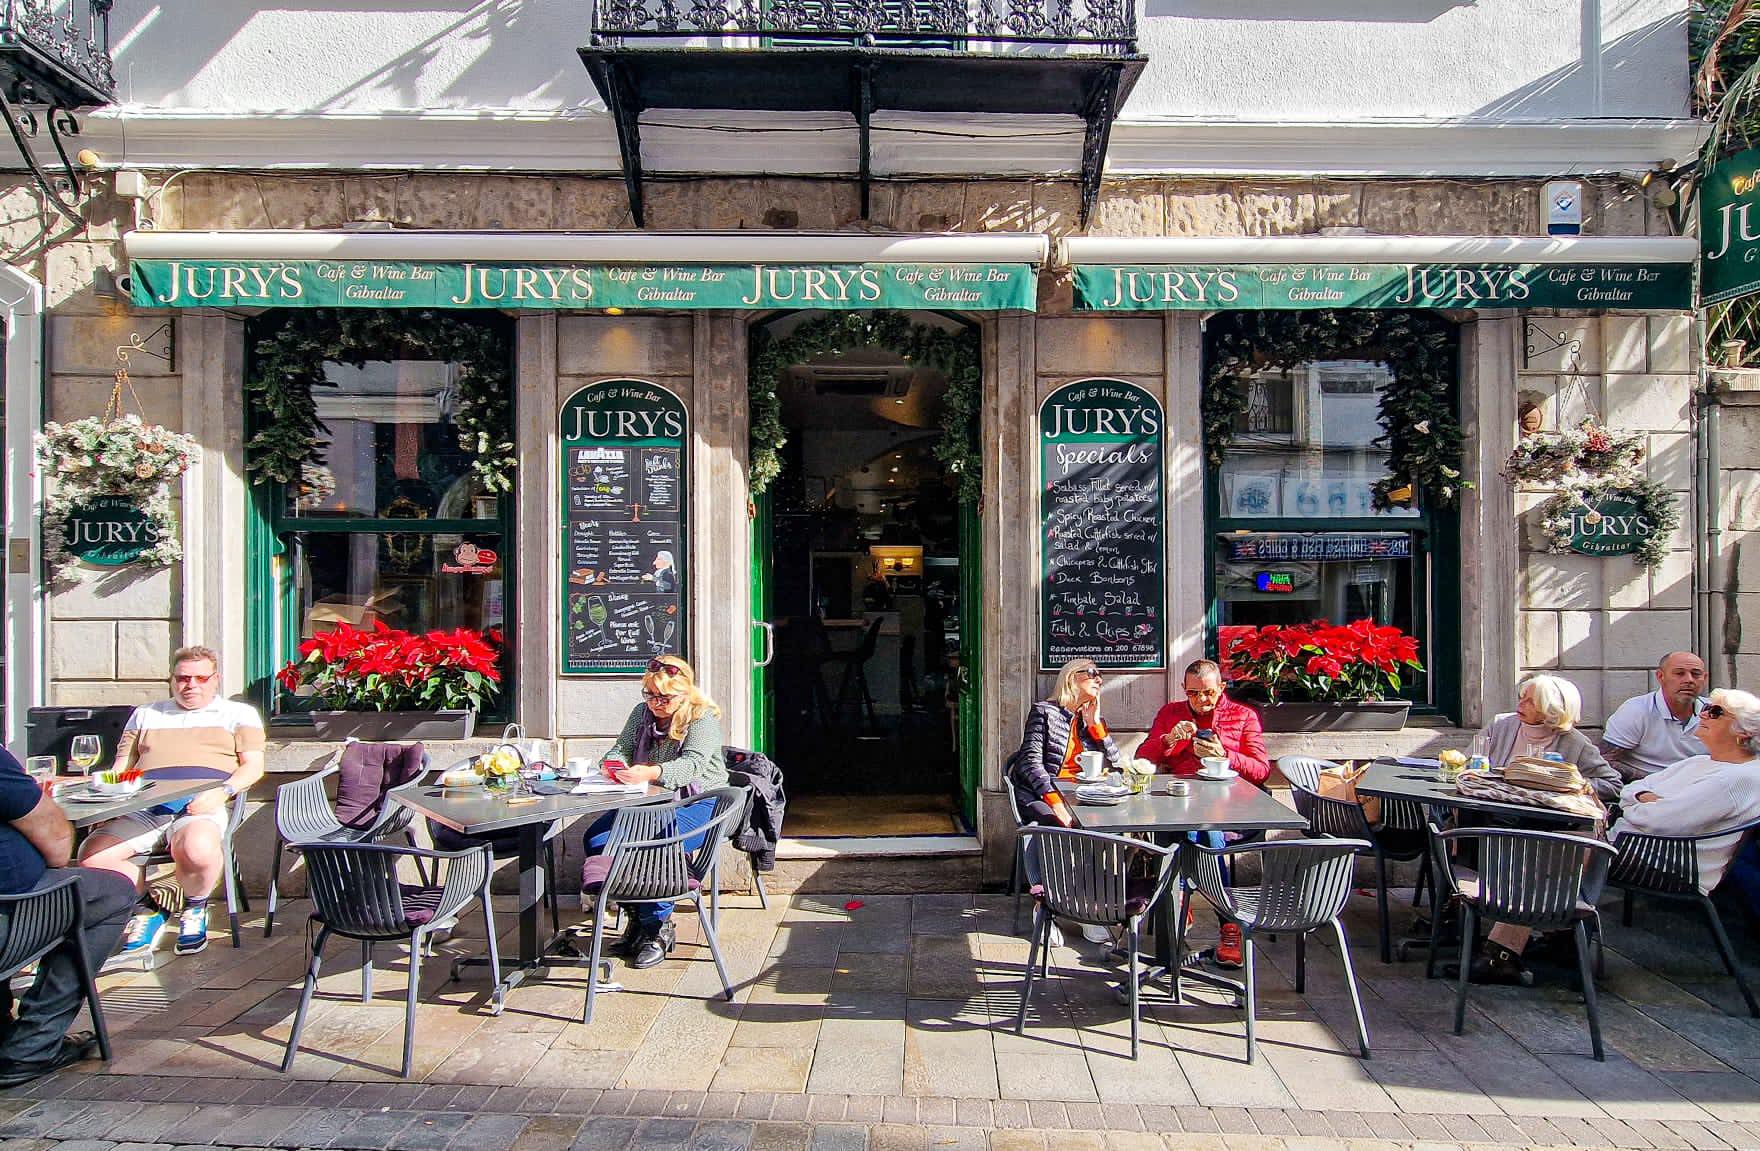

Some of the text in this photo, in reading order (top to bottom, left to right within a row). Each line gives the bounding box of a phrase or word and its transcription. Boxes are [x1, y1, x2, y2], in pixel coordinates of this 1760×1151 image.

[351, 264, 368, 279] &
[372, 265, 406, 280] Wine
[410, 266, 436, 280] Bar
[641, 267, 657, 281] &
[663, 267, 697, 281] Wine
[700, 267, 726, 281] Bar
[928, 268, 944, 281] &
[949, 268, 982, 281] Wine
[985, 268, 1010, 282] Bar
[1291, 268, 1307, 281] &
[1312, 268, 1345, 281] Wine
[1348, 268, 1373, 281] Bar
[1580, 268, 1596, 282] &
[1600, 268, 1633, 282] Wine
[1636, 268, 1660, 282] Bar
[159, 262, 302, 303] JURY'S
[452, 263, 593, 304] JURY'S
[742, 264, 881, 304] JURY'S
[1104, 267, 1239, 307] JURY'S
[1396, 266, 1530, 303] JURY'S
[346, 284, 405, 300] Gibraltar
[637, 287, 696, 301] Gibraltar
[924, 287, 982, 302] Gibraltar
[1288, 287, 1344, 301] Gibraltar
[1577, 287, 1633, 301] Gibraltar
[607, 388, 618, 398] &
[621, 388, 643, 399] Wine
[645, 391, 661, 402] Bar
[1088, 388, 1098, 398] &
[1101, 388, 1123, 399] Wine
[1124, 391, 1140, 402] Bar
[566, 406, 682, 441] JURY'S
[1045, 405, 1158, 438] JURY'S
[1056, 443, 1153, 475] Specials
[1055, 493, 1089, 503] roasted
[1093, 493, 1114, 510] baby
[1056, 508, 1082, 527] Spicy
[66, 518, 159, 545] JURY'S
[1583, 541, 1631, 552] Gibraltar
[1104, 590, 1141, 606] Salad
